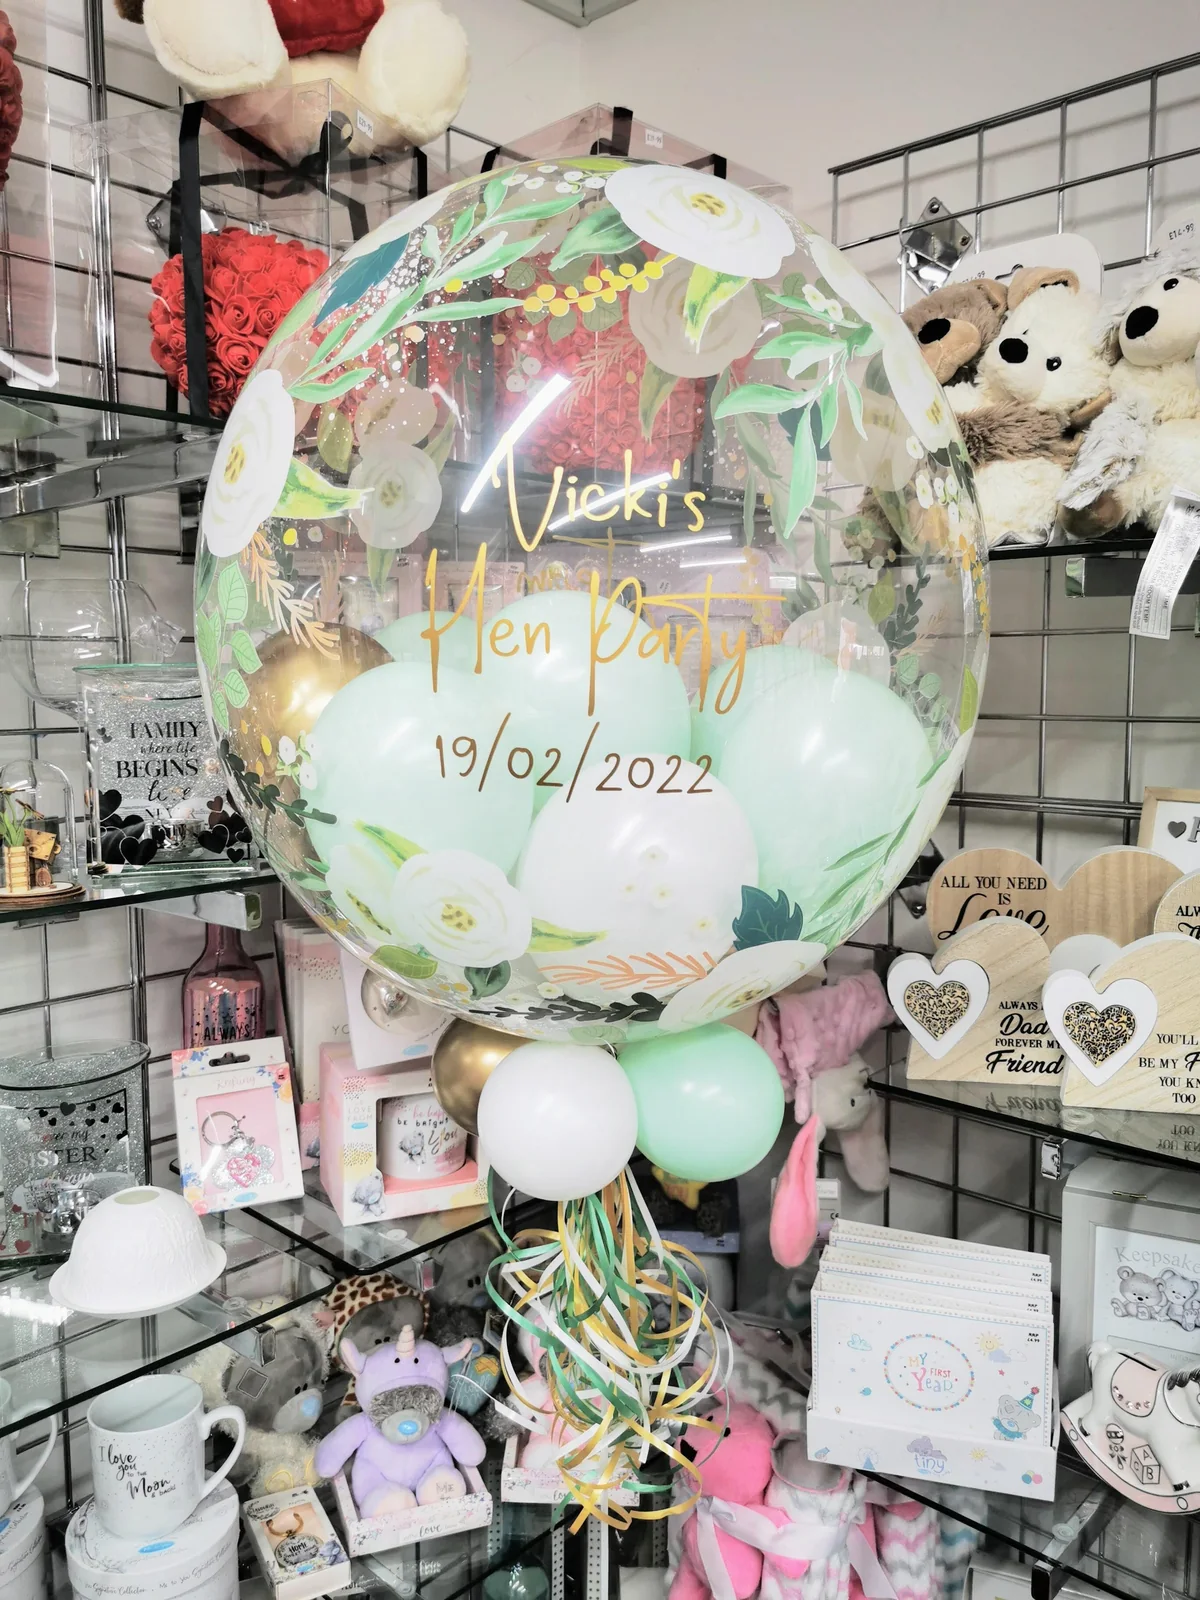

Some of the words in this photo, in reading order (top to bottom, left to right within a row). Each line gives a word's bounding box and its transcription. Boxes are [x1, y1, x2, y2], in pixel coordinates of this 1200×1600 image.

[491, 443, 706, 552] Vicki's
[420, 542, 551, 693] Hen
[587, 570, 788, 717] Party
[130, 721, 201, 739] FAMILY
[140, 742, 173, 754] where
[436, 712, 713, 803] 19/02/2022
[116, 758, 198, 779] BEGINS
[940, 876, 970, 889] ALL
[974, 876, 1002, 890] YOU
[1006, 876, 1047, 890] NEED
[997, 893, 1011, 906] IS
[998, 1001, 1038, 1011] ALWAYS
[999, 1012, 1050, 1036] Dad
[204, 1023, 252, 1042] ALWAYS
[1156, 1033, 1199, 1047] YOU'LL
[995, 1038, 1042, 1049] FOREVER
[1046, 1040, 1060, 1050] MY
[985, 1049, 1065, 1075] Friend
[1138, 1057, 1156, 1069] BE
[1159, 1058, 1179, 1070] MY
[1159, 1076, 1182, 1088] YOU
[1172, 1092, 1197, 1104] TOO
[71, 1130, 90, 1142] my
[908, 1352, 928, 1368] MY
[930, 1367, 951, 1379] FIRST
[107, 1443, 138, 1466] love
[1142, 1448, 1153, 1461] A
[914, 1453, 945, 1474] tiny
[1133, 1460, 1140, 1471] C
[116, 1462, 138, 1481] you
[1146, 1466, 1154, 1481] B
[126, 1477, 172, 1500] Moon
[419, 1523, 443, 1538] love
[288, 1541, 308, 1555] HOME
